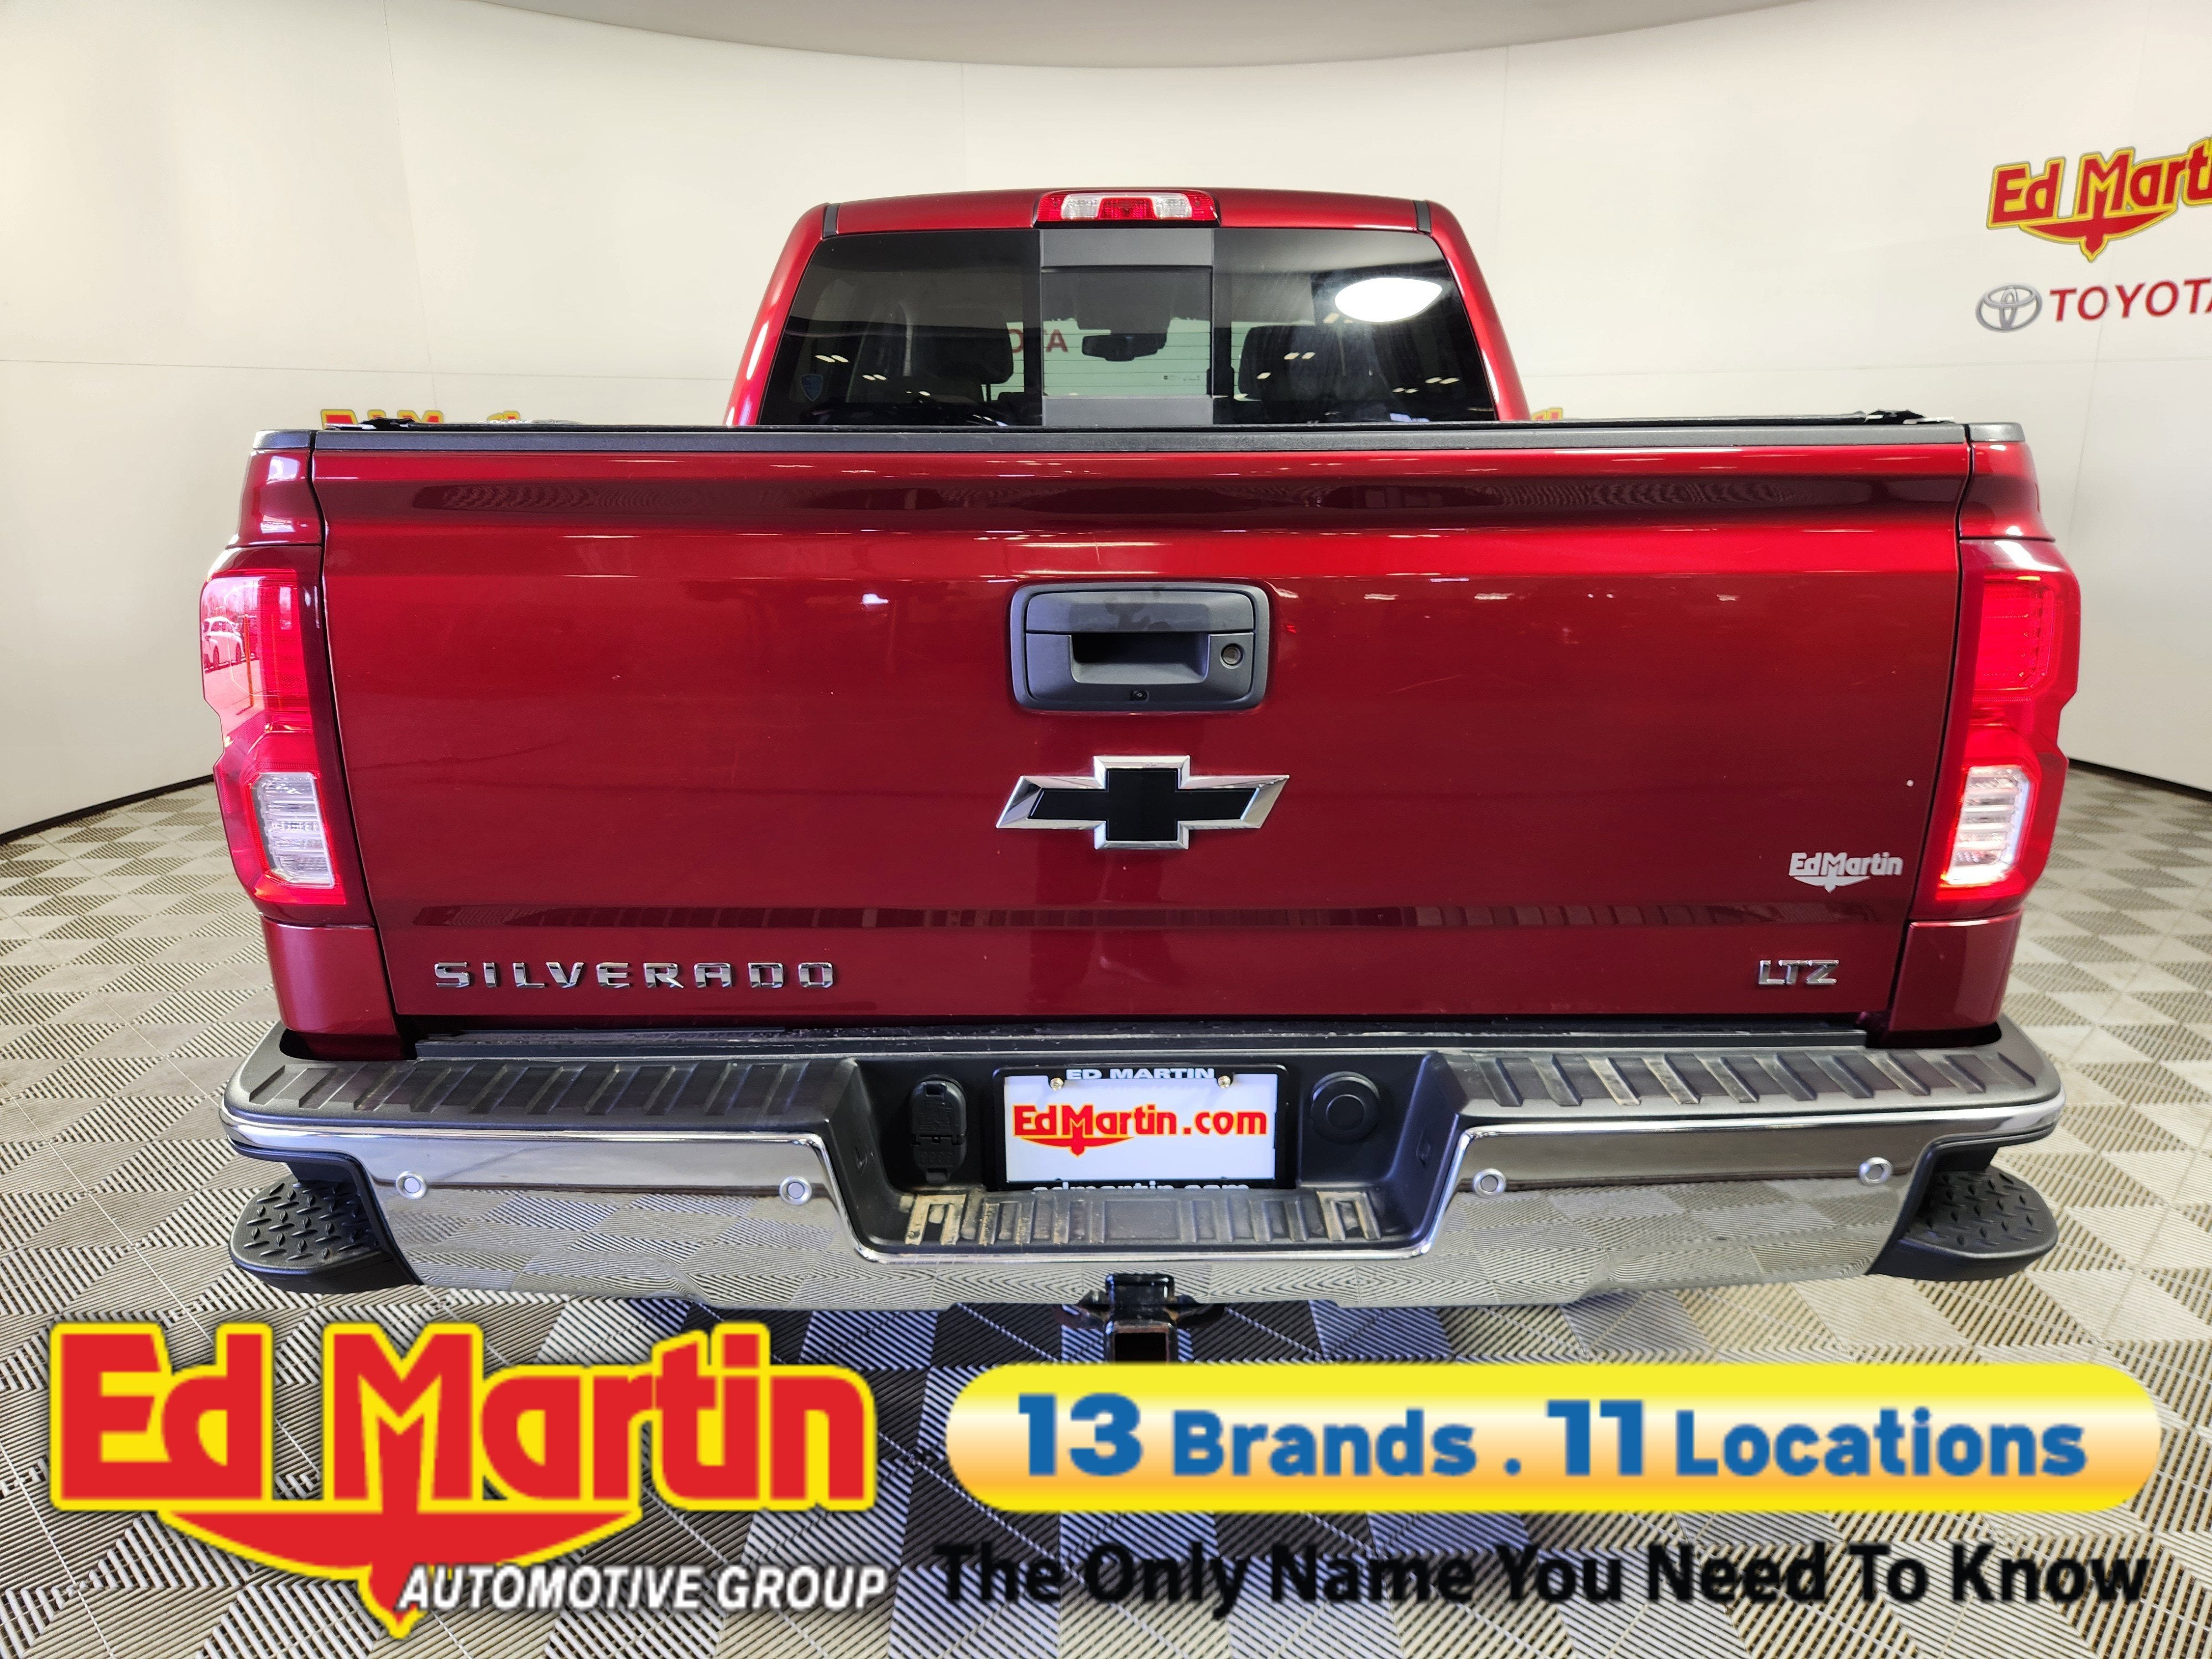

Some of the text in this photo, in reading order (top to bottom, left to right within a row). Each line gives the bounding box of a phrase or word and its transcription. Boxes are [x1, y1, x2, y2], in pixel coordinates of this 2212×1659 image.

[1989, 137, 2212, 228] Ed Mart
[2049, 278, 2212, 322] TOYOT
[434, 962, 835, 988] SILVERADO
[1759, 959, 1839, 985] LTZ
[1066, 1068, 1215, 1079] ED MARTIN
